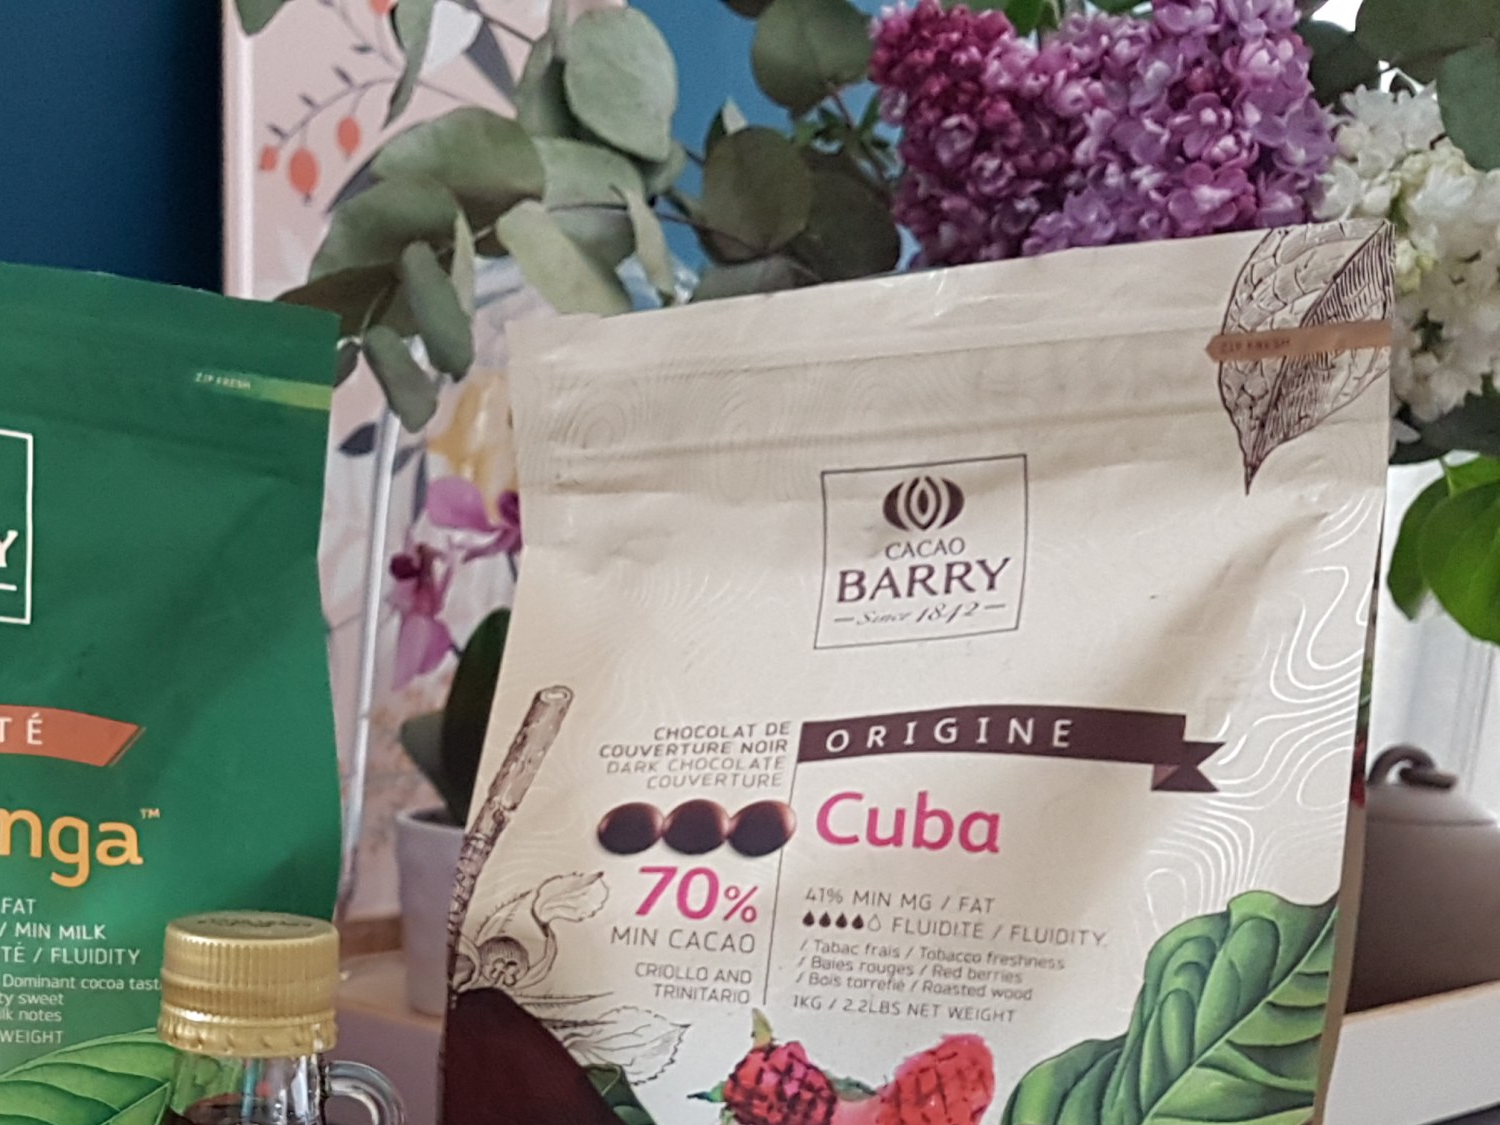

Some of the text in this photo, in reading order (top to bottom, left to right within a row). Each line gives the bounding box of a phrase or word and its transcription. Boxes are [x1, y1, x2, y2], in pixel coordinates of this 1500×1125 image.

[884, 536, 966, 561] CACAO
[835, 556, 1012, 603] BARRY
[915, 600, 980, 624] 1842
[653, 720, 792, 742] CHOCOLAT DE
[825, 716, 1073, 753] ORIGINE
[599, 738, 789, 759] COUVERTURE NOIR
[606, 756, 788, 775] DARK CHOCOLATE
[646, 772, 783, 790] COUVERTURE
[815, 789, 1000, 854] Cuba
[1, 898, 37, 915] FAT
[635, 866, 760, 924] 70%
[804, 887, 997, 914] 41% MIN MG FAT
[14, 922, 51, 940] MIN
[58, 924, 107, 941] MILK
[610, 925, 757, 955] MIN CACAO
[1010, 923, 1107, 947] FLUIDITY
[50, 947, 141, 966] FLUIDITY
[813, 939, 1066, 971] Tabac frais Tobacco freshness
[2, 974, 76, 989] Dominant
[80, 978, 125, 990] cocoa
[129, 977, 162, 991] tast
[634, 961, 753, 985] CRIOLLO AND
[810, 956, 1023, 985] Baies rouges Red berries
[654, 983, 751, 1006] TRINITARIO
[808, 972, 842, 988] Bois
[922, 978, 987, 998] Roasted
[991, 984, 1034, 1001] wood
[18, 993, 65, 1006] sweet
[793, 994, 1017, 1023] 1KG 2.2LBS NET WEIGHT
[19, 1010, 63, 1023] notes
[0, 1030, 65, 1044] WEIGHT
